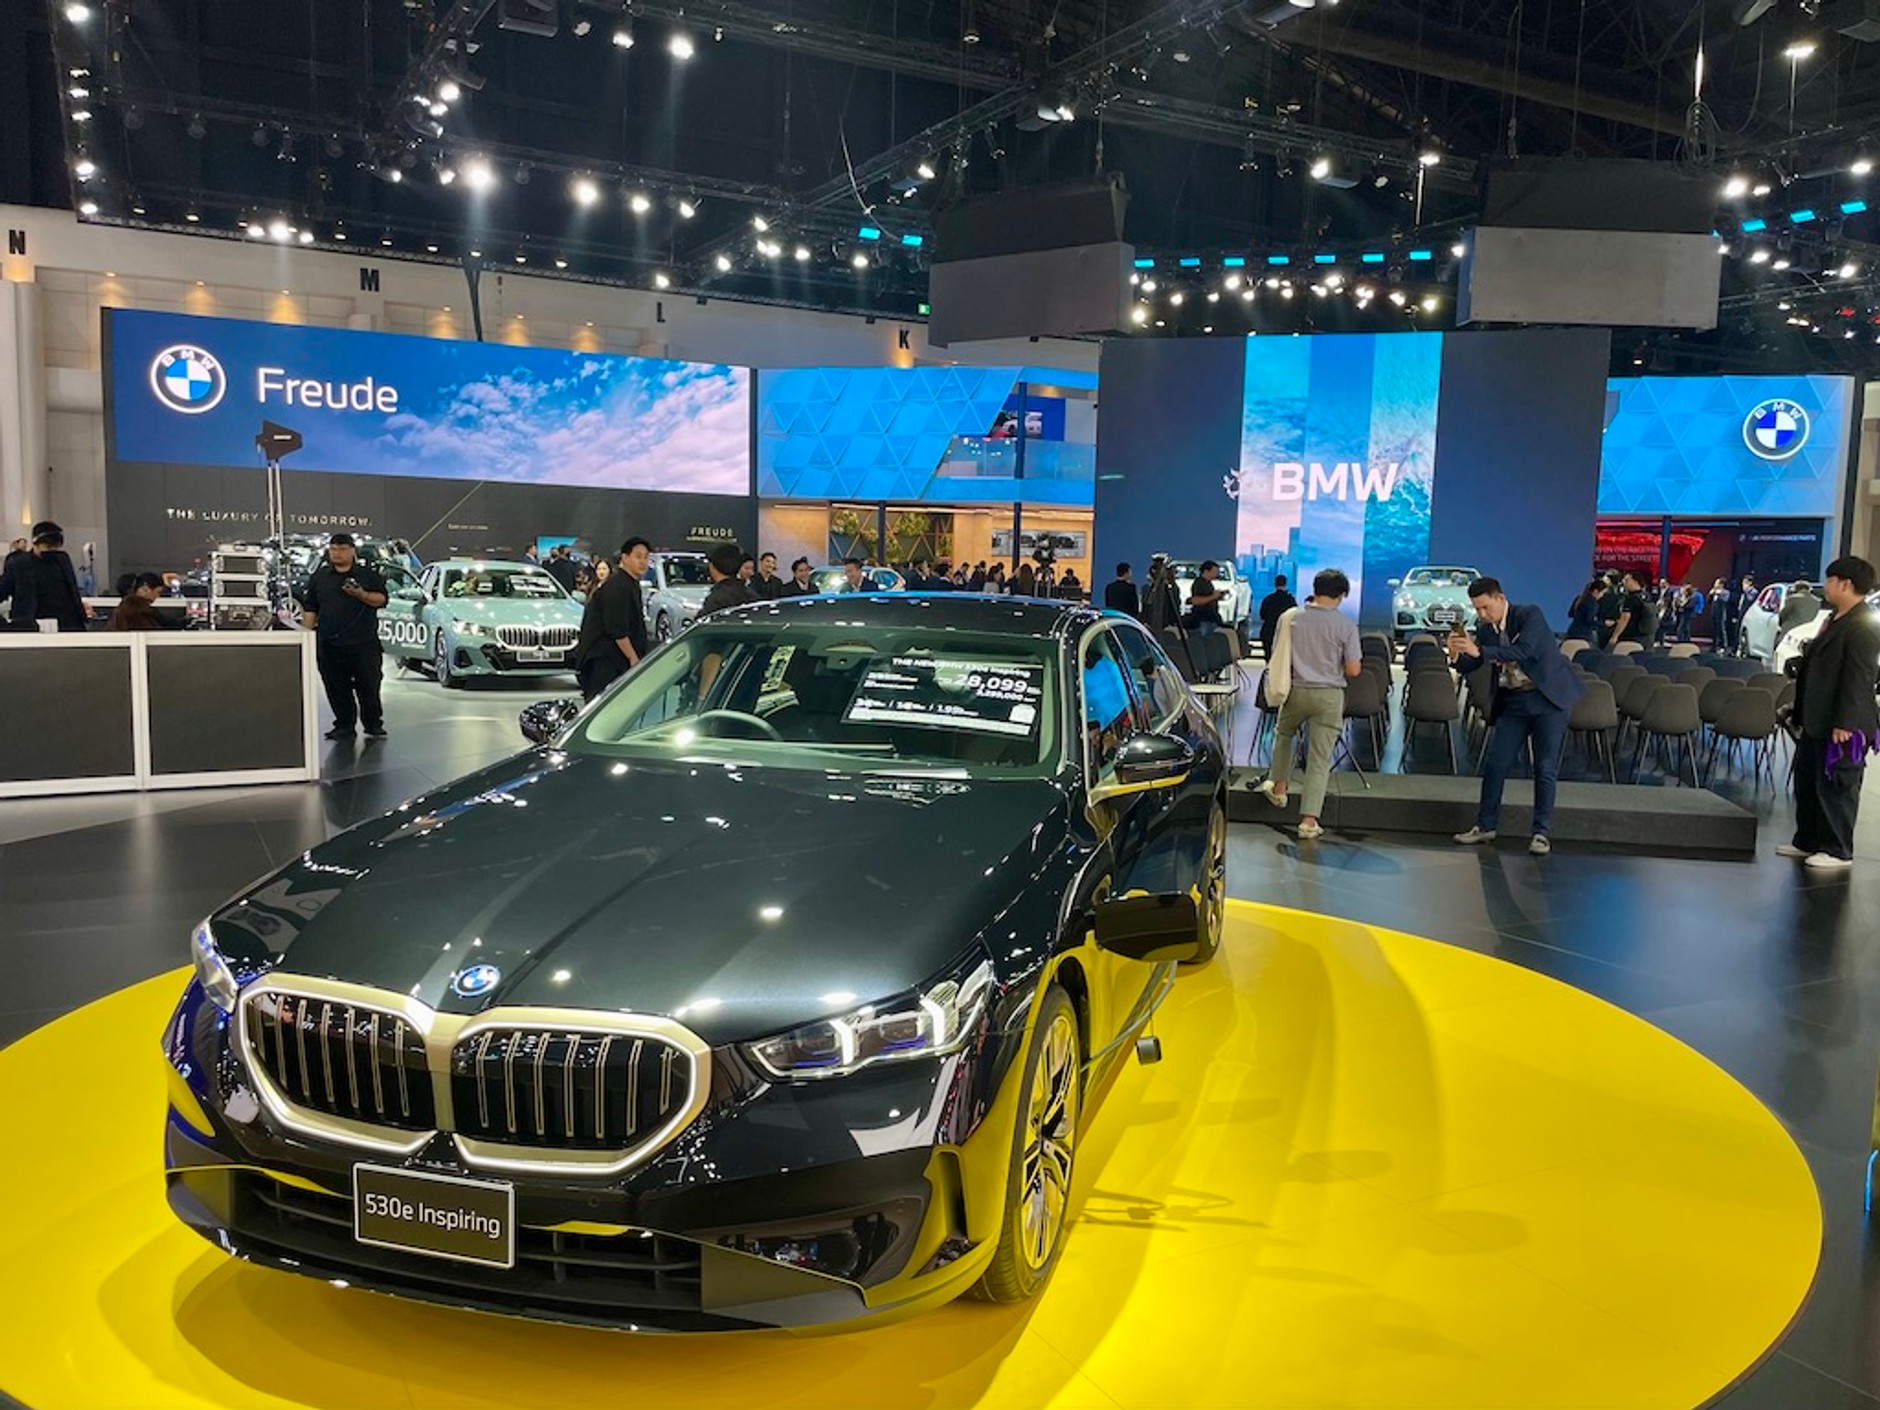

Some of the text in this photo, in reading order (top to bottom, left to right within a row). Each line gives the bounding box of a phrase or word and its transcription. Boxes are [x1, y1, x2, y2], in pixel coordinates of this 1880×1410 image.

[9, 230, 25, 255] N
[360, 268, 380, 292] M
[657, 302, 666, 323] L
[899, 329, 910, 350] K
[257, 366, 400, 413] Freude
[1272, 462, 1399, 501] BMW
[167, 508, 196, 521] THE
[955, 673, 1028, 693] 28,099
[365, 1192, 501, 1240] 530e Inspiring
